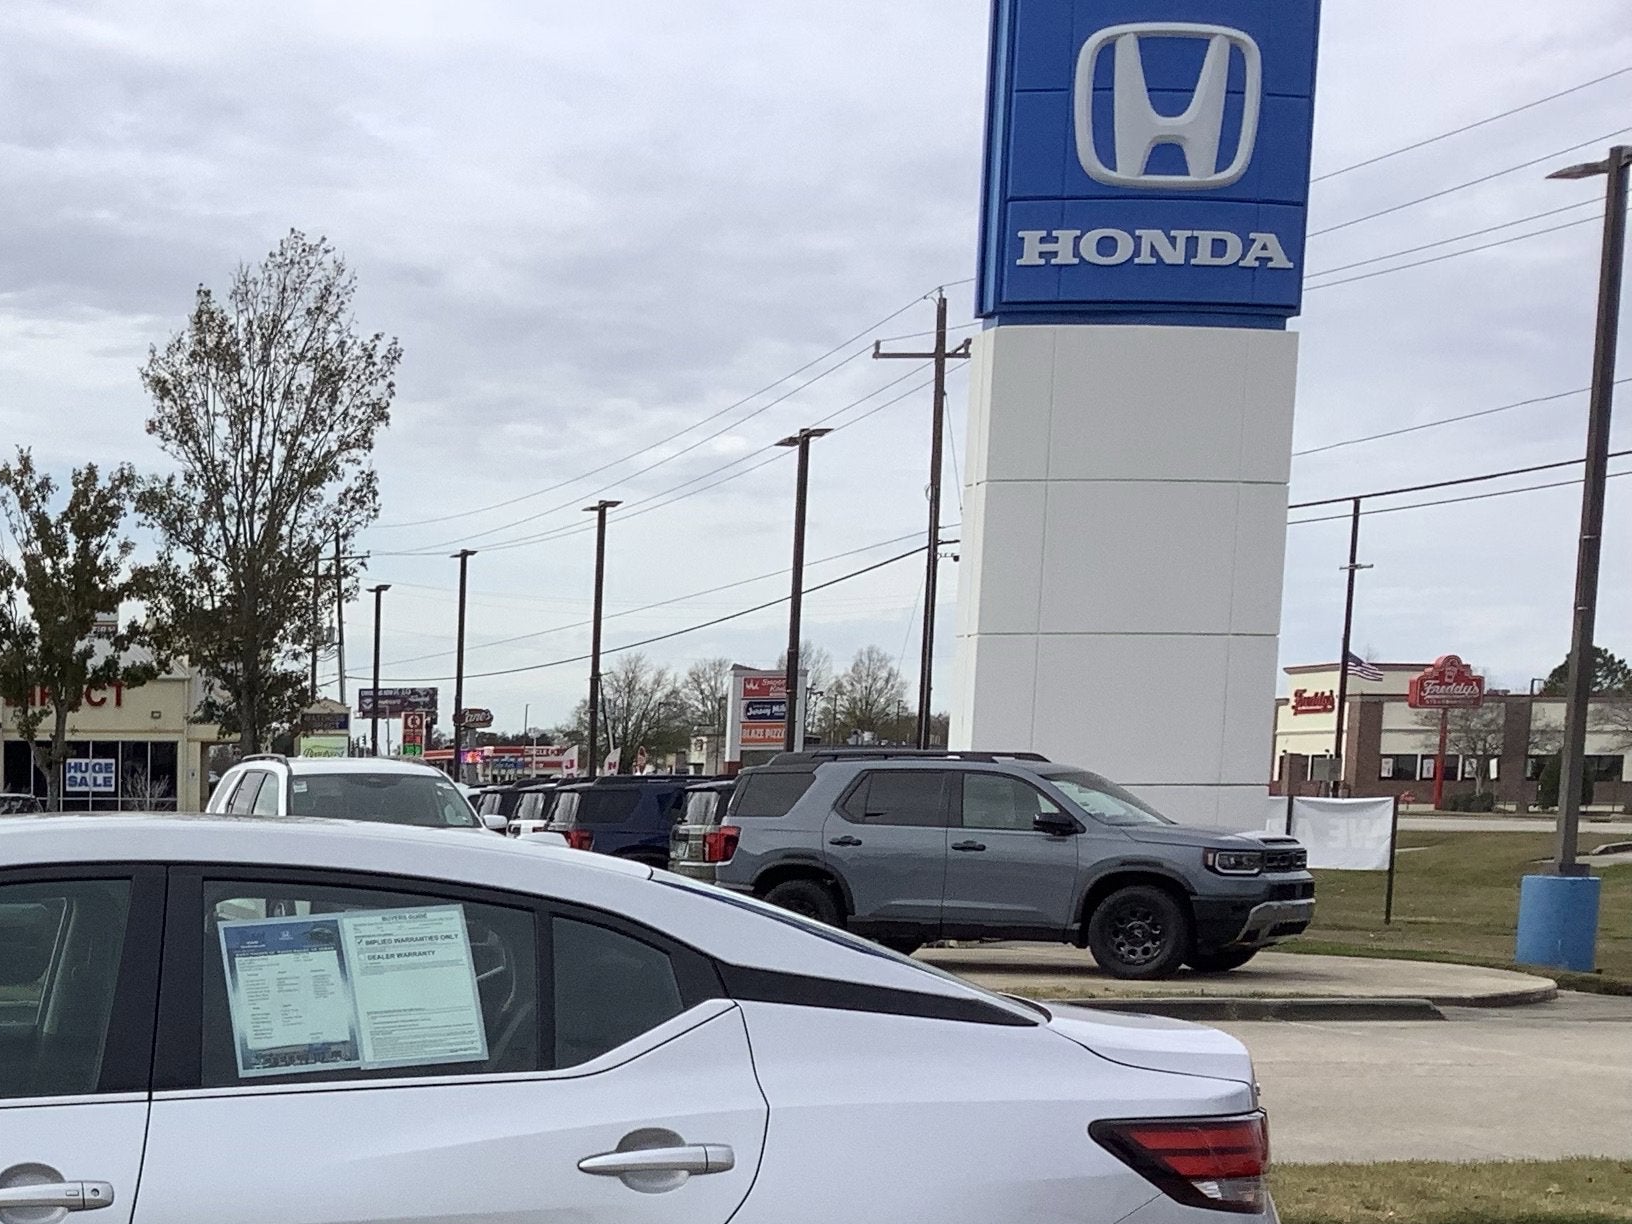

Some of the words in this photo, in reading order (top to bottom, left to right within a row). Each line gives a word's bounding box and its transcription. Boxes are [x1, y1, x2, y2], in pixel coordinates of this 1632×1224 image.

[1016, 228, 1294, 269] HONDA
[5, 681, 126, 707] ICT
[1420, 679, 1480, 698] Freddy's
[461, 708, 490, 726] ane's
[67, 761, 114, 774] HUGE
[67, 775, 113, 787] SALE
[394, 934, 439, 945] WARRANTIES
[440, 933, 459, 941] ONLY
[368, 953, 396, 961] DEALER
[396, 950, 436, 959] WARRANTY
